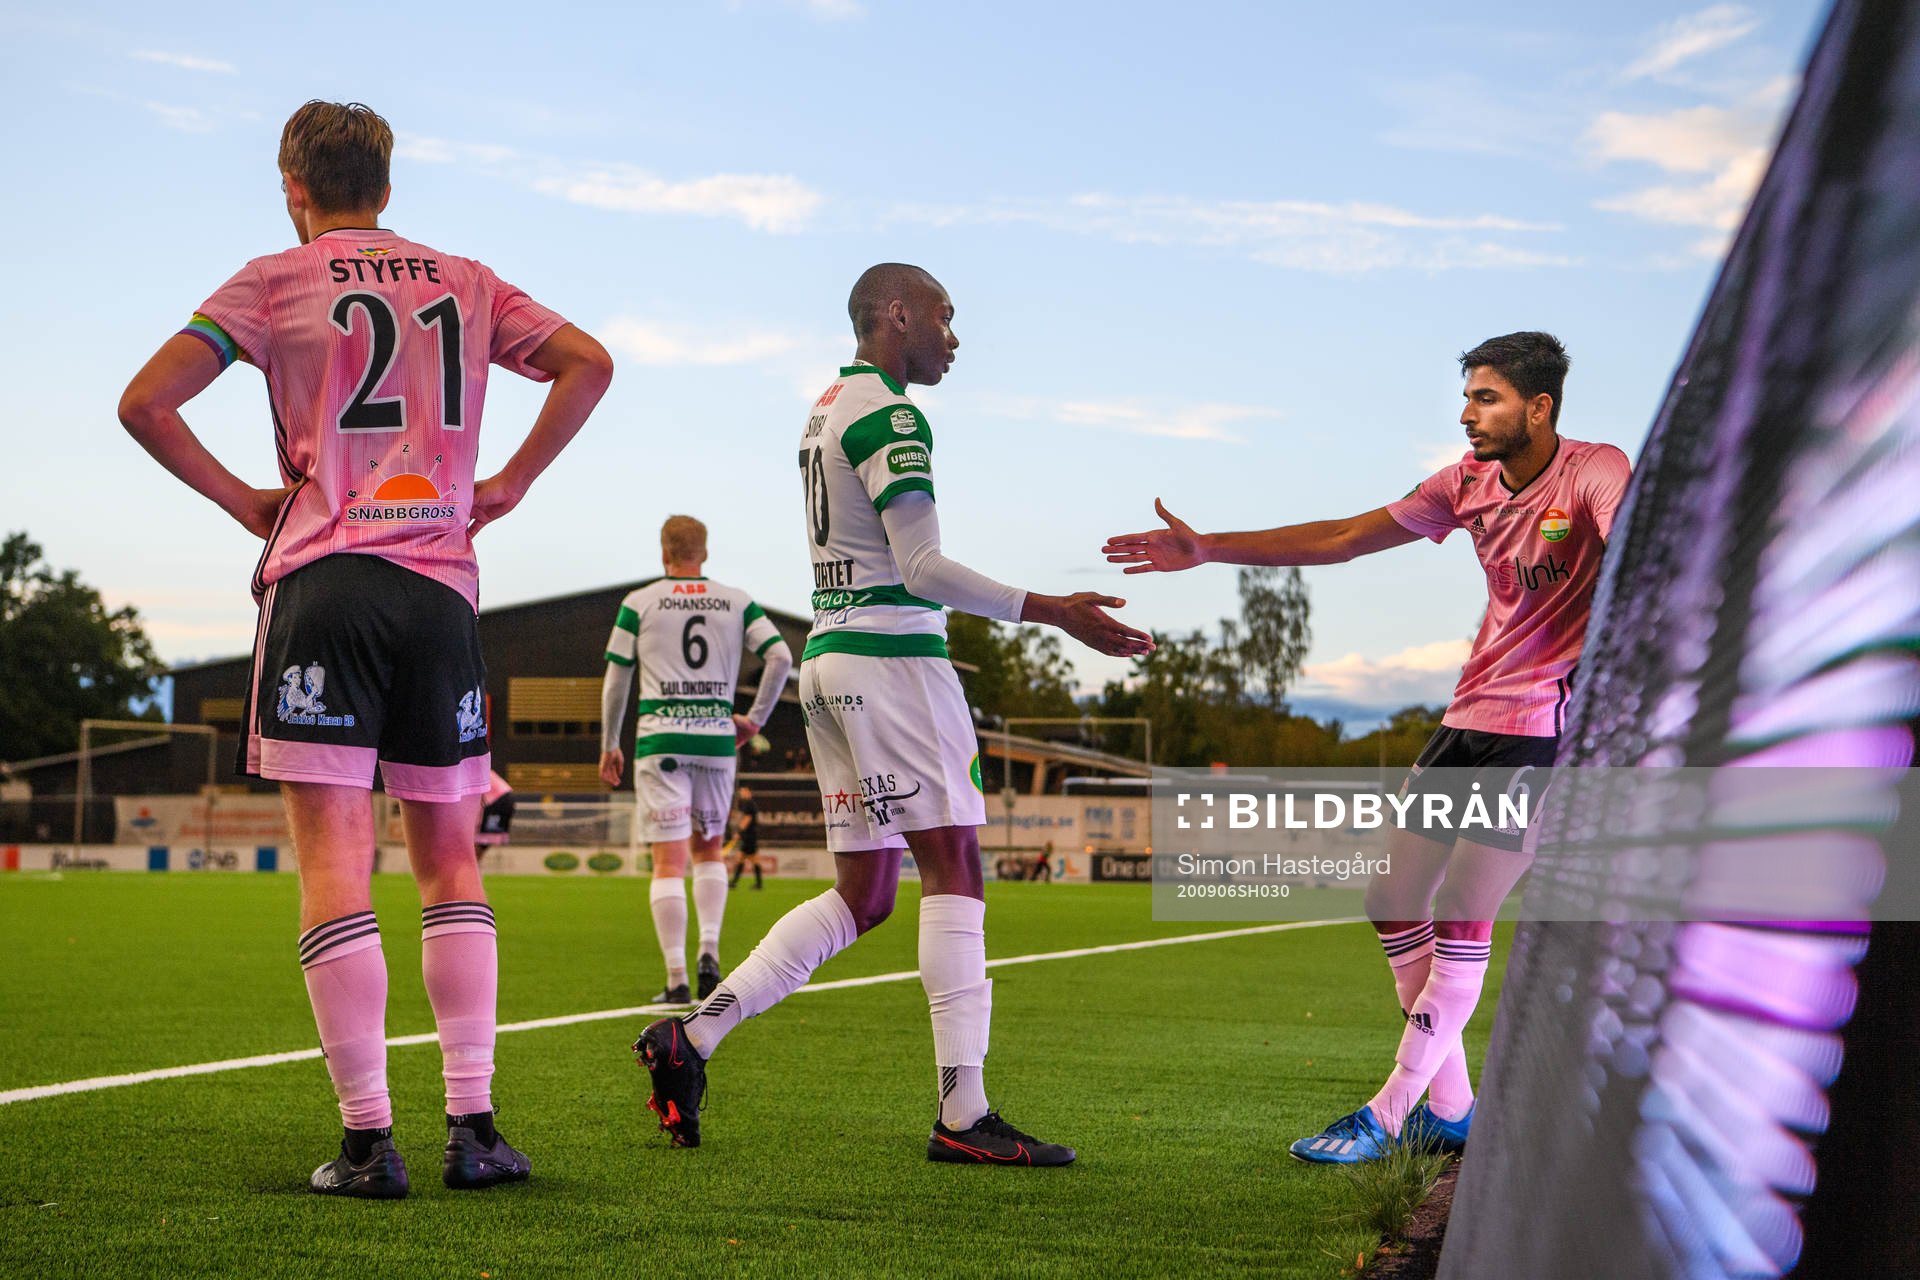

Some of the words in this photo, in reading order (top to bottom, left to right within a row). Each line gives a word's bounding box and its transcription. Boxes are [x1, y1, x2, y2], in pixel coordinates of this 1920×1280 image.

[329, 257, 441, 285] STYFFE
[328, 289, 465, 434] 21
[891, 452, 928, 464] UNIBET
[347, 507, 456, 521] SNABBGROSS
[813, 559, 855, 588] ORTET
[672, 583, 707, 595] ABB
[658, 597, 731, 612] JOHANSSON
[682, 615, 709, 670] 6
[1101, 856, 1133, 878] One
